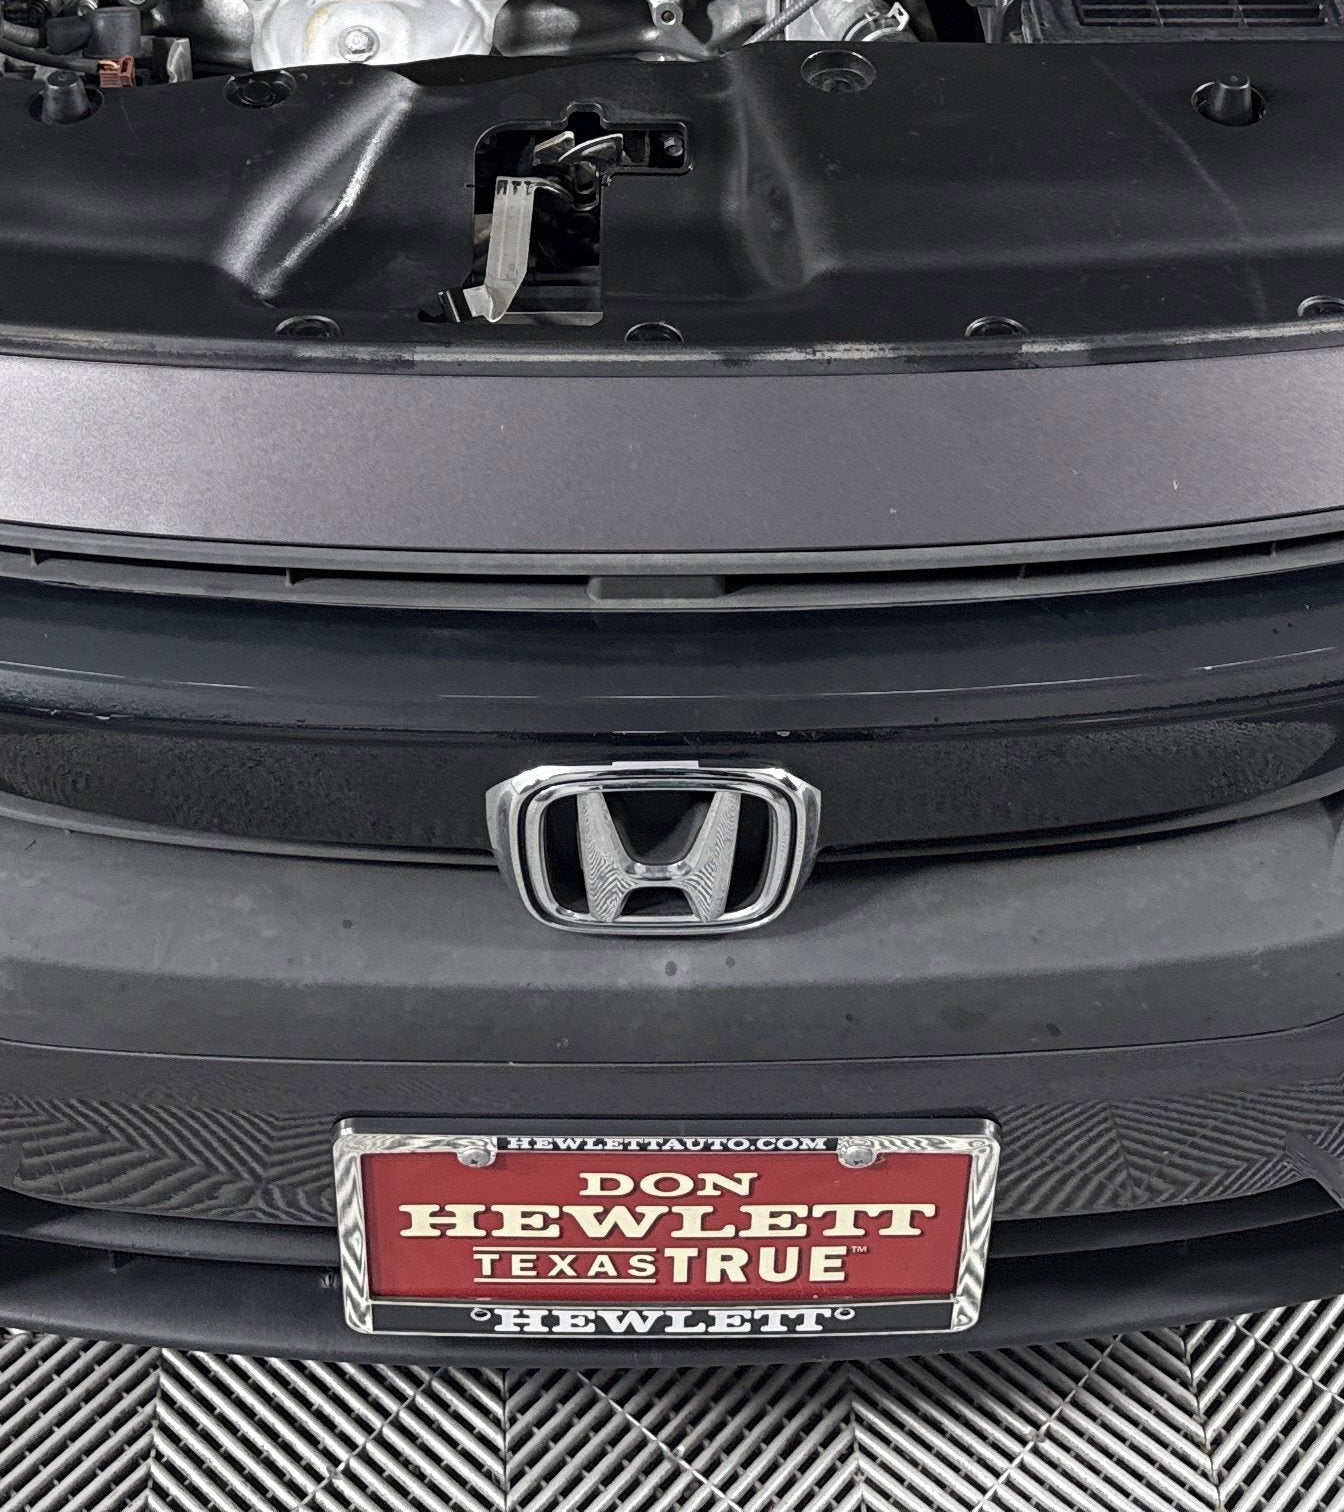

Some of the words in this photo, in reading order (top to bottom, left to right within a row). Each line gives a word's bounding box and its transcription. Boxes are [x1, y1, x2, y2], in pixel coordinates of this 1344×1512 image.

[506, 1136, 828, 1151] HEWLETTAUTO.COM
[578, 1172, 758, 1198] DON
[398, 1203, 936, 1239] HEWLETT
[493, 1308, 832, 1333] HEWLETT
